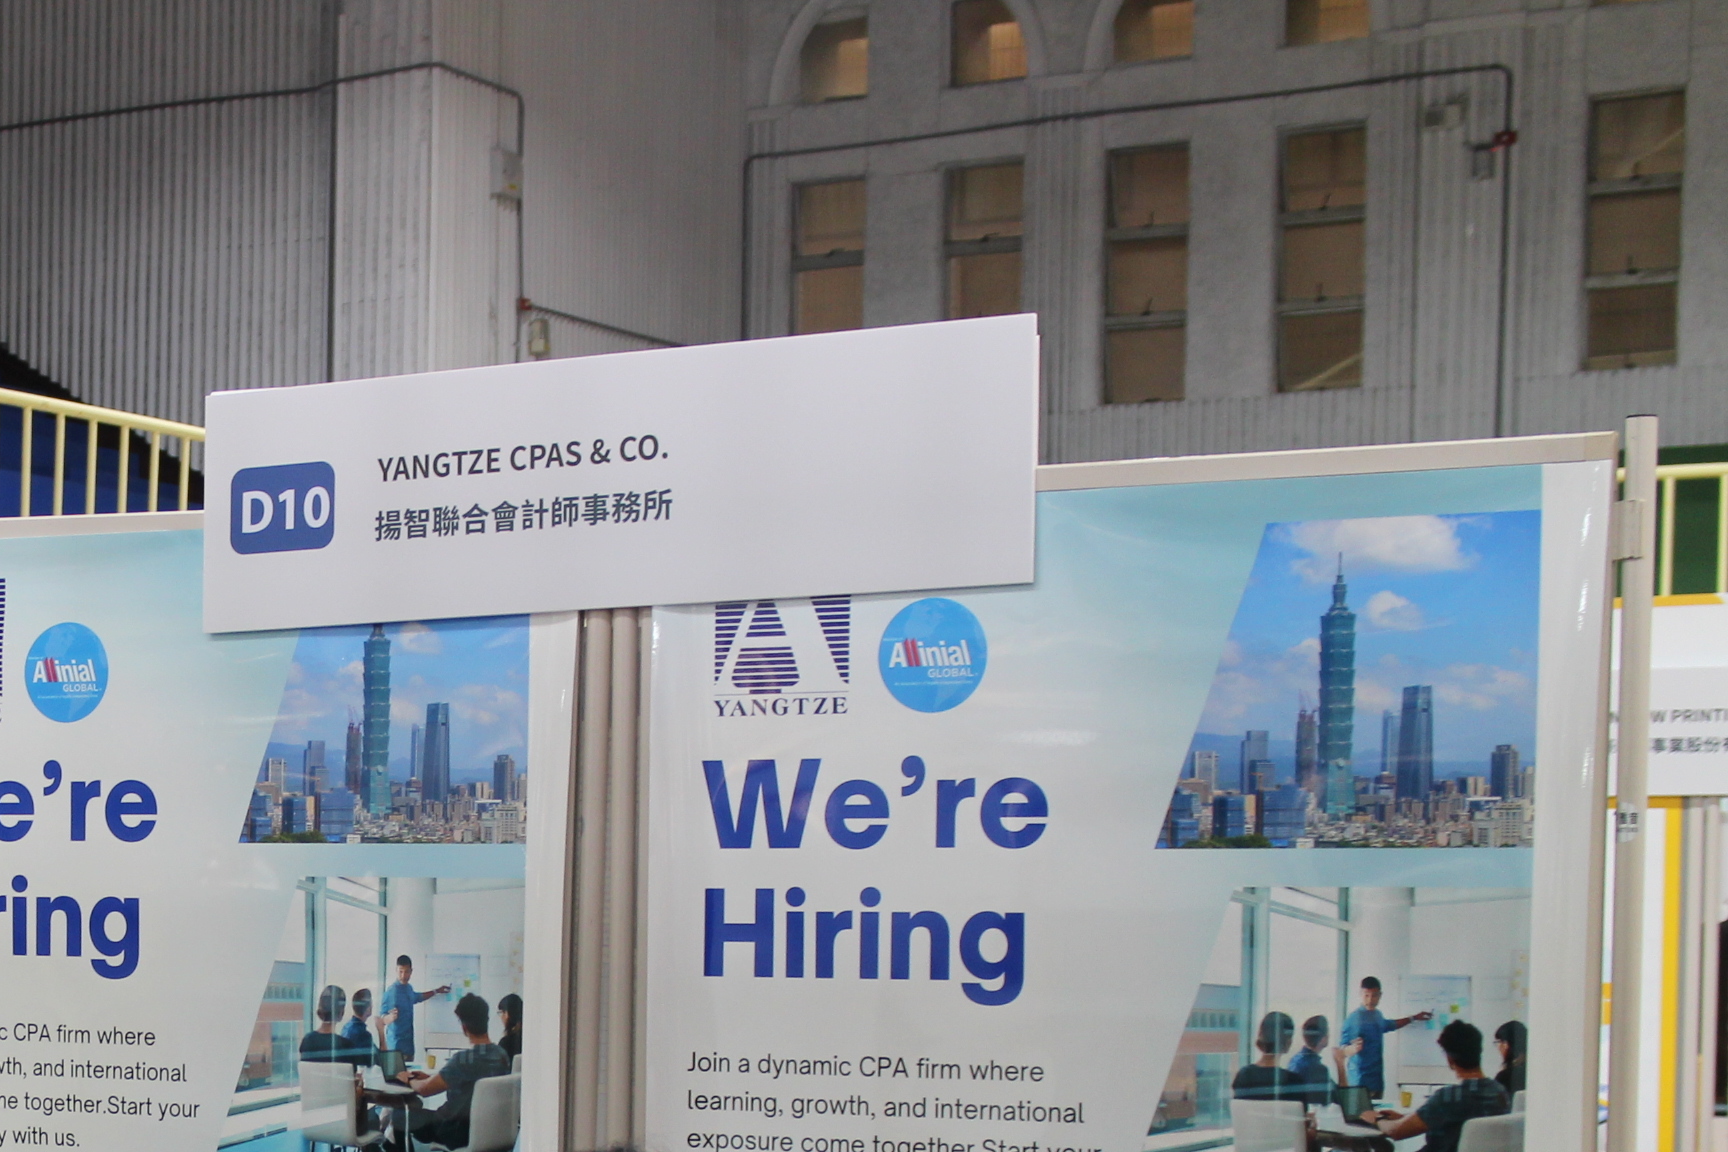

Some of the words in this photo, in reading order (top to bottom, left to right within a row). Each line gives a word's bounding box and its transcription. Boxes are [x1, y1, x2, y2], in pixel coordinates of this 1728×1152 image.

[378, 447, 501, 482] YANGTZE
[509, 440, 582, 473] CPAS
[589, 440, 612, 465] &
[619, 434, 670, 462] CO.
[240, 485, 331, 534] D10
[374, 488, 673, 543] 揚智聯合會計師事務所
[889, 638, 972, 668] Allinial
[33, 657, 96, 683] Allinial
[927, 667, 974, 678] GLOBAL
[62, 683, 99, 693] GLOBAL
[714, 696, 849, 718] YANGTZE
[702, 755, 1049, 850] We’re
[704, 886, 1026, 1006] Hiring
[13, 1022, 52, 1043] CPA
[56, 1024, 91, 1044] firm
[96, 1026, 156, 1046] where
[33, 1059, 65, 1078] and
[70, 1059, 187, 1083] international
[687, 1052, 731, 1074] Join
[738, 1058, 751, 1074] a
[757, 1054, 851, 1079] dynamic
[859, 1056, 909, 1078] CPA
[916, 1058, 961, 1080] firm
[969, 1061, 1044, 1082] where
[158, 1100, 200, 1121] your
[687, 1090, 783, 1118] learning,
[791, 1095, 876, 1120] growth,
[883, 1098, 927, 1118] and
[934, 1098, 1084, 1124] international
[12, 1126, 49, 1146] with
[54, 1129, 80, 1147] us.
